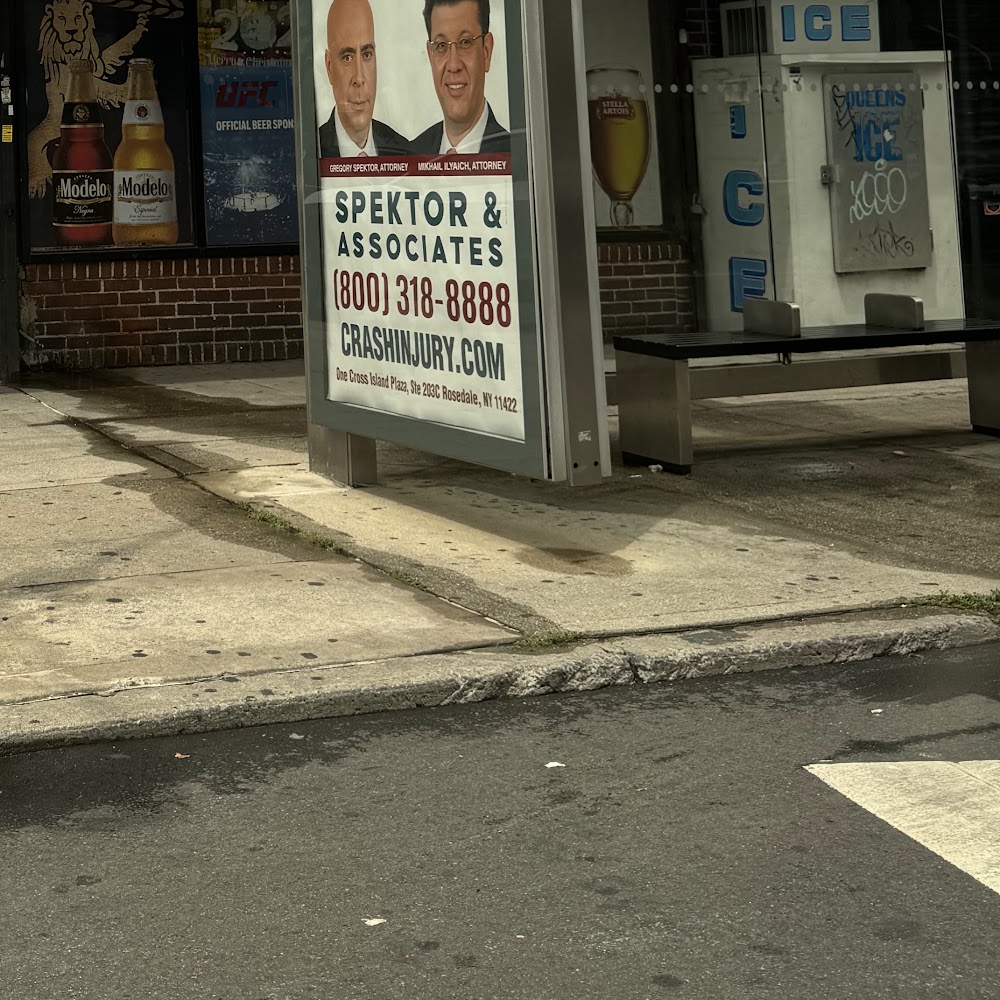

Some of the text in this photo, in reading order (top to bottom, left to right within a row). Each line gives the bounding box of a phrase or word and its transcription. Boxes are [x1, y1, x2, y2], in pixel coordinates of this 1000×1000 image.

[780, 4, 871, 43] ICE
[215, 81, 279, 108] UFC
[844, 88, 906, 108] QUEENS
[216, 119, 294, 131] OFFICIAL BEER SPON
[852, 111, 904, 163] ICE
[329, 162, 409, 173] GREGORY SPEKTOR, ATTORNEY
[418, 162, 443, 171] MIKHAIL
[472, 160, 507, 170] ATTORNEY
[60, 178, 107, 198] Modelo
[122, 177, 168, 196] Modelo
[335, 190, 468, 228] SPEKTOR
[483, 190, 503, 229] &
[337, 231, 504, 268] ASSOCIATES
[334, 268, 512, 328] (800) 318-8888
[341, 321, 506, 382] CRASHINJURY.COM
[336, 367, 518, 413] One Cross Island Plaza, Ste 203C Rosedale, NY 11422
